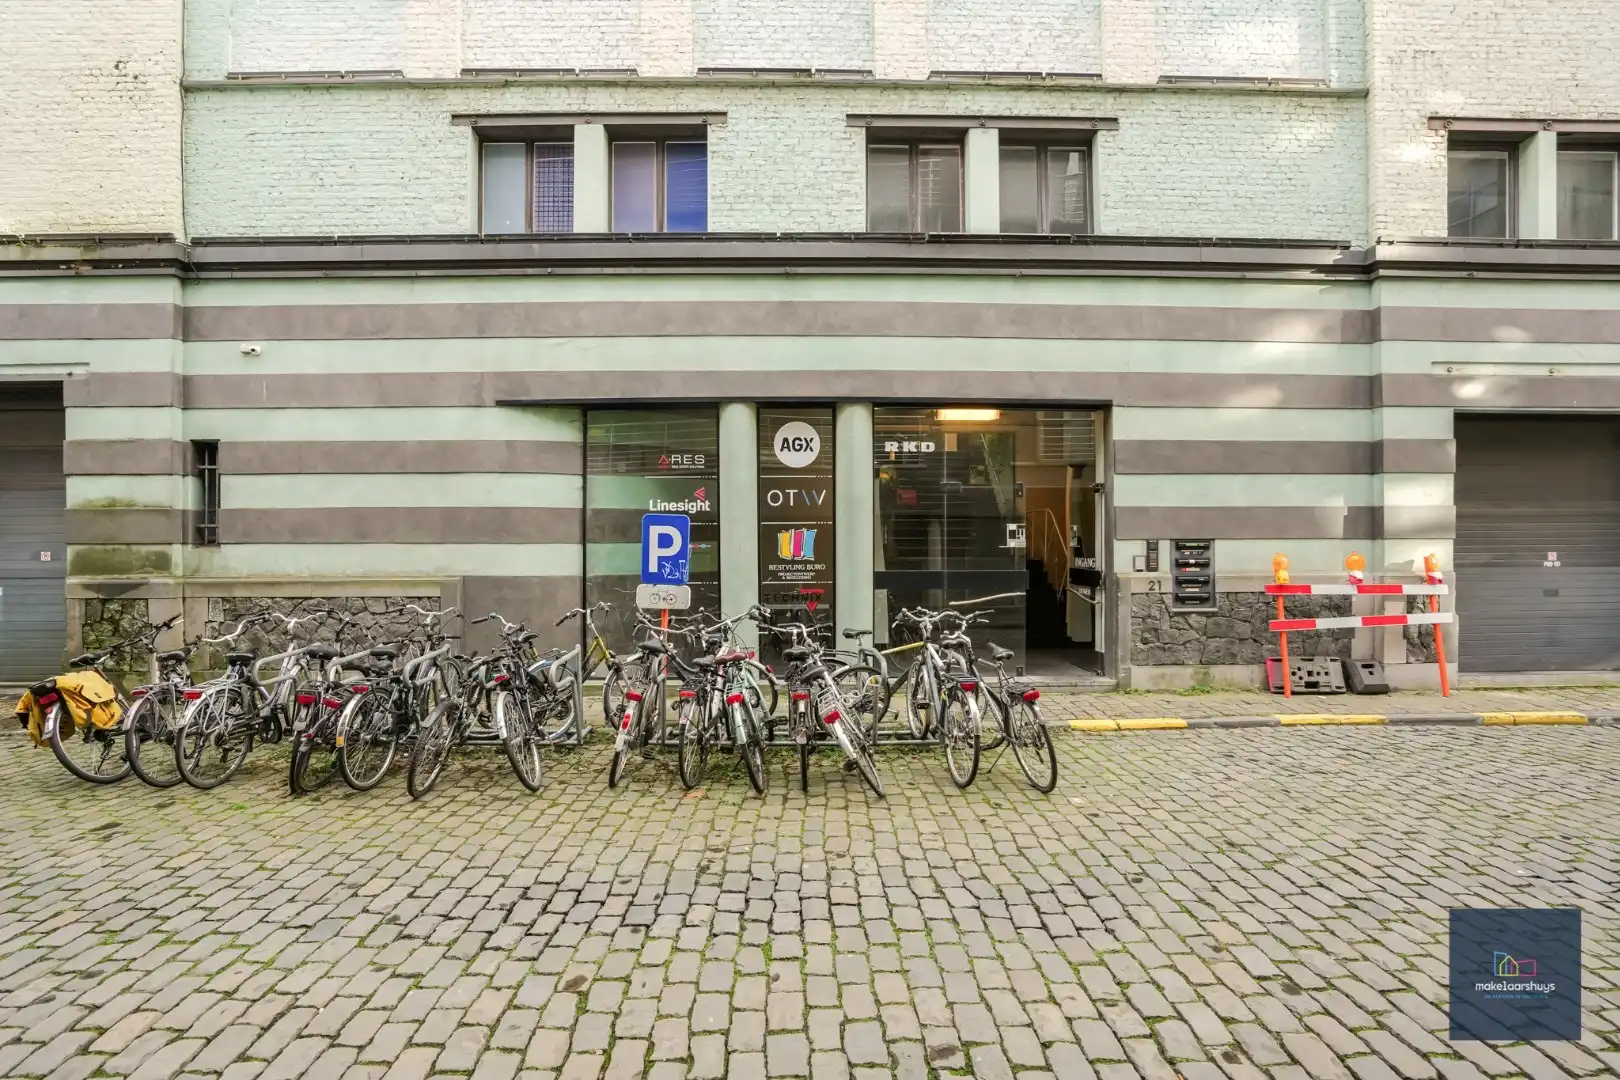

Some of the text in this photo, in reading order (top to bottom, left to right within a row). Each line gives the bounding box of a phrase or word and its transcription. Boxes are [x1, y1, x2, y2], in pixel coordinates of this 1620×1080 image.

[780, 437, 814, 453] AGX
[884, 441, 935, 452] RKD
[658, 454, 705, 465] ARES
[649, 499, 710, 514] Linesight
[648, 525, 682, 573] P
[1075, 557, 1096, 568] INGANG
[1148, 580, 1162, 592] 21
[763, 593, 823, 602] TECHNIX
